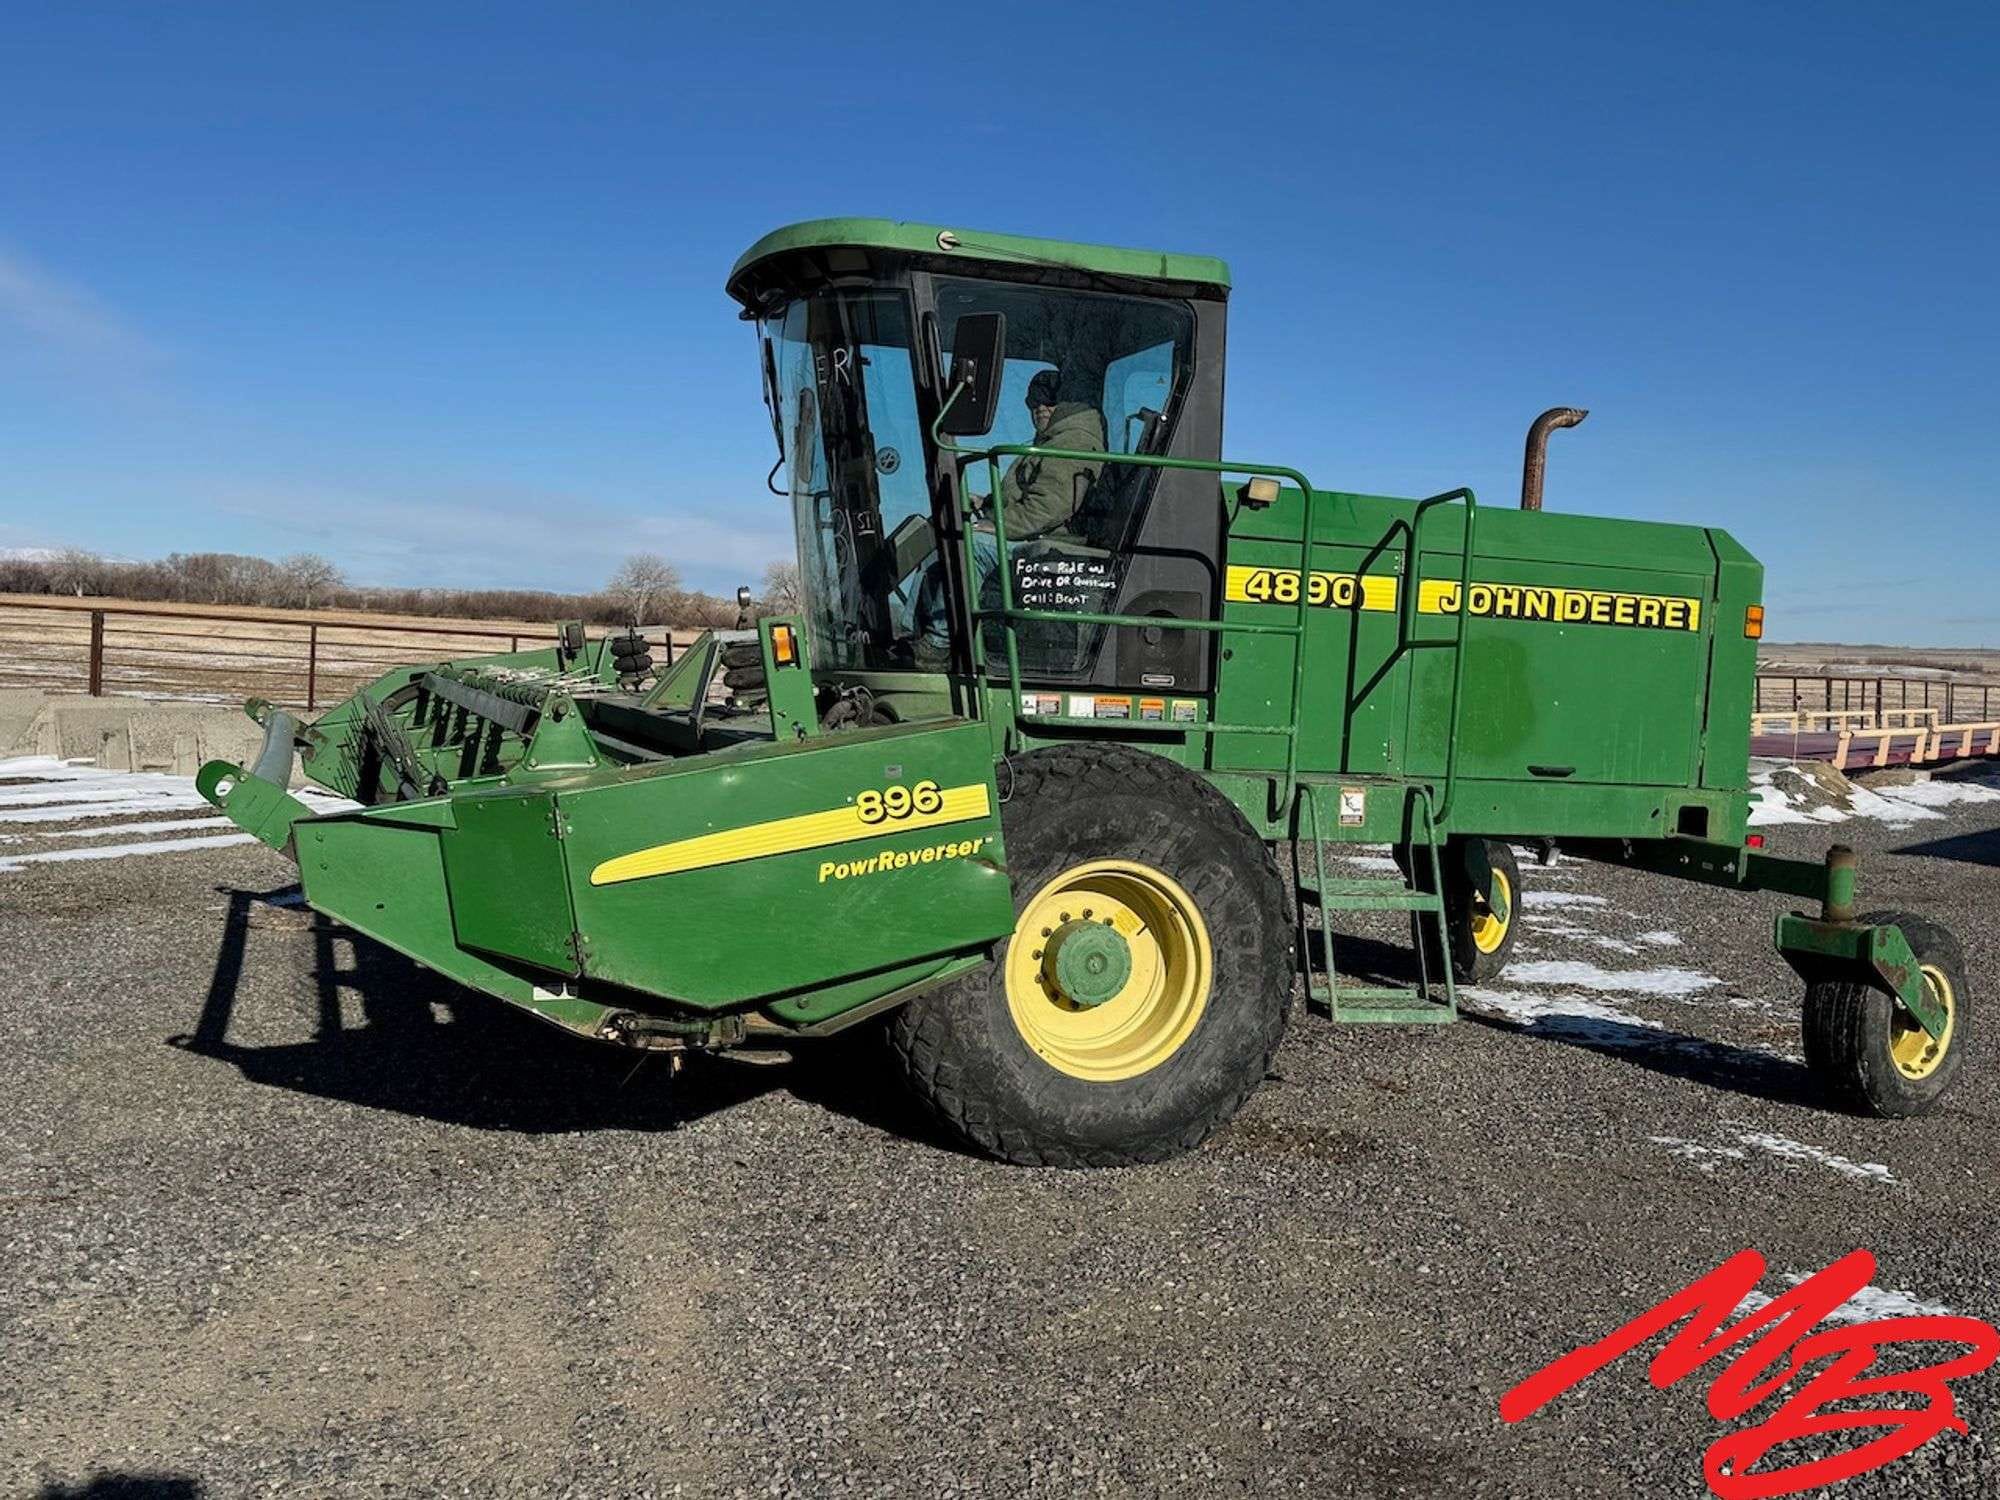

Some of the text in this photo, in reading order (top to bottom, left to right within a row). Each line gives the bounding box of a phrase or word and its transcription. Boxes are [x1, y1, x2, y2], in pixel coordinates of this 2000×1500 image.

[1016, 558, 1039, 575] For
[1246, 571, 1362, 608] 4890
[1439, 584, 1691, 630] JOHN DEERE
[856, 779, 943, 825] 896
[818, 837, 984, 884] PowrReverser
